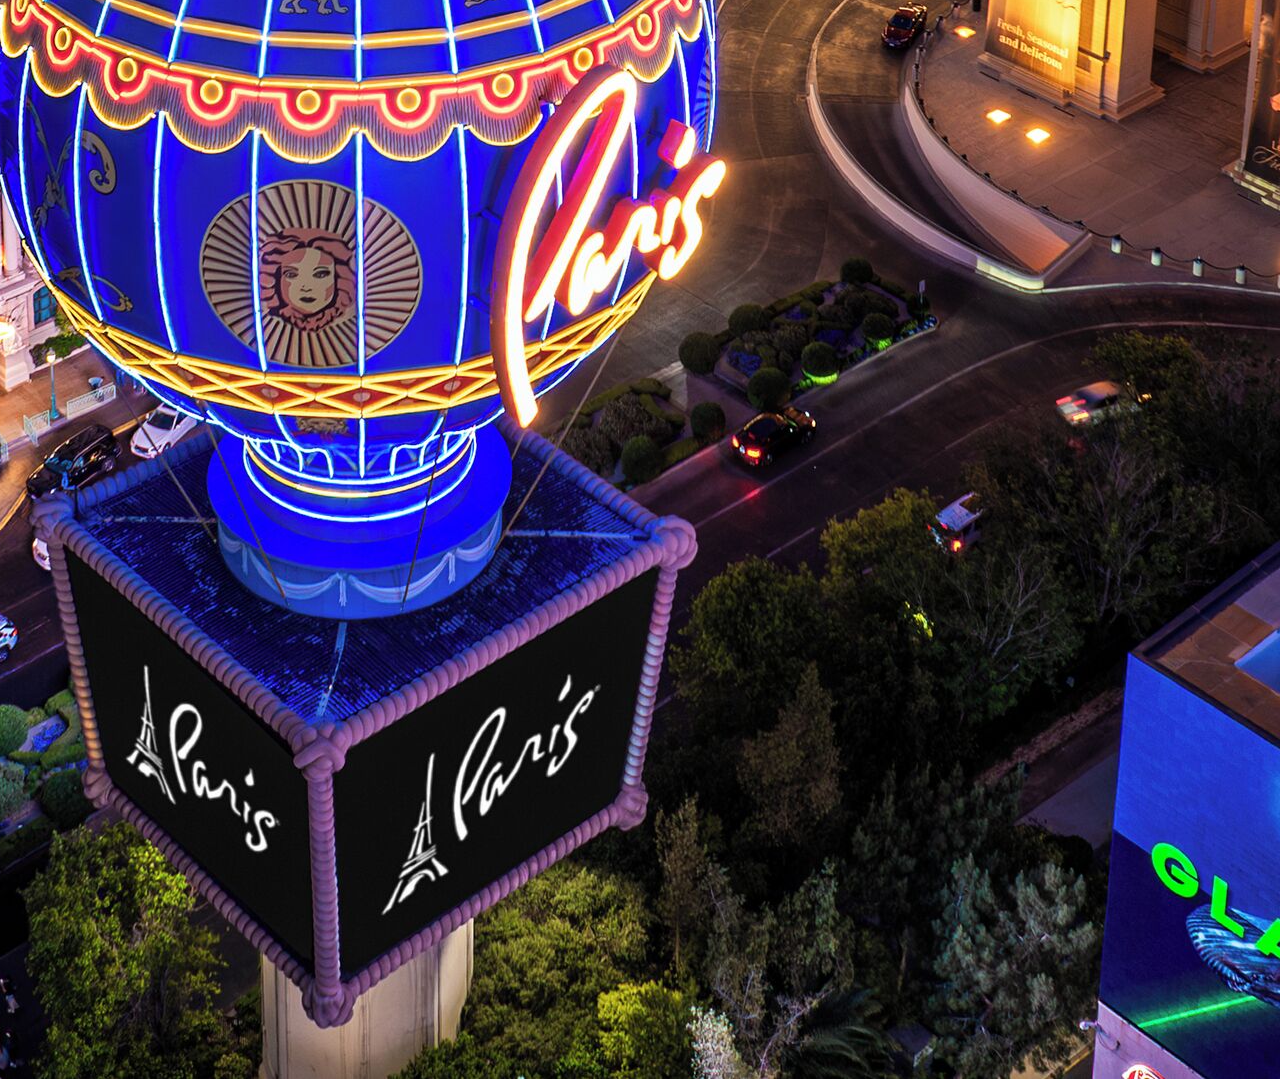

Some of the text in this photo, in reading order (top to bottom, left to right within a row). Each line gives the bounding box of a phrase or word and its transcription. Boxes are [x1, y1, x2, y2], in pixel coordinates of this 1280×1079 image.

[997, 17, 1069, 59] Fresh, Seasonal
[999, 34, 1063, 71] and Delicious
[491, 65, 728, 429] Paris
[169, 703, 276, 852] Paris
[453, 674, 594, 840] Paris
